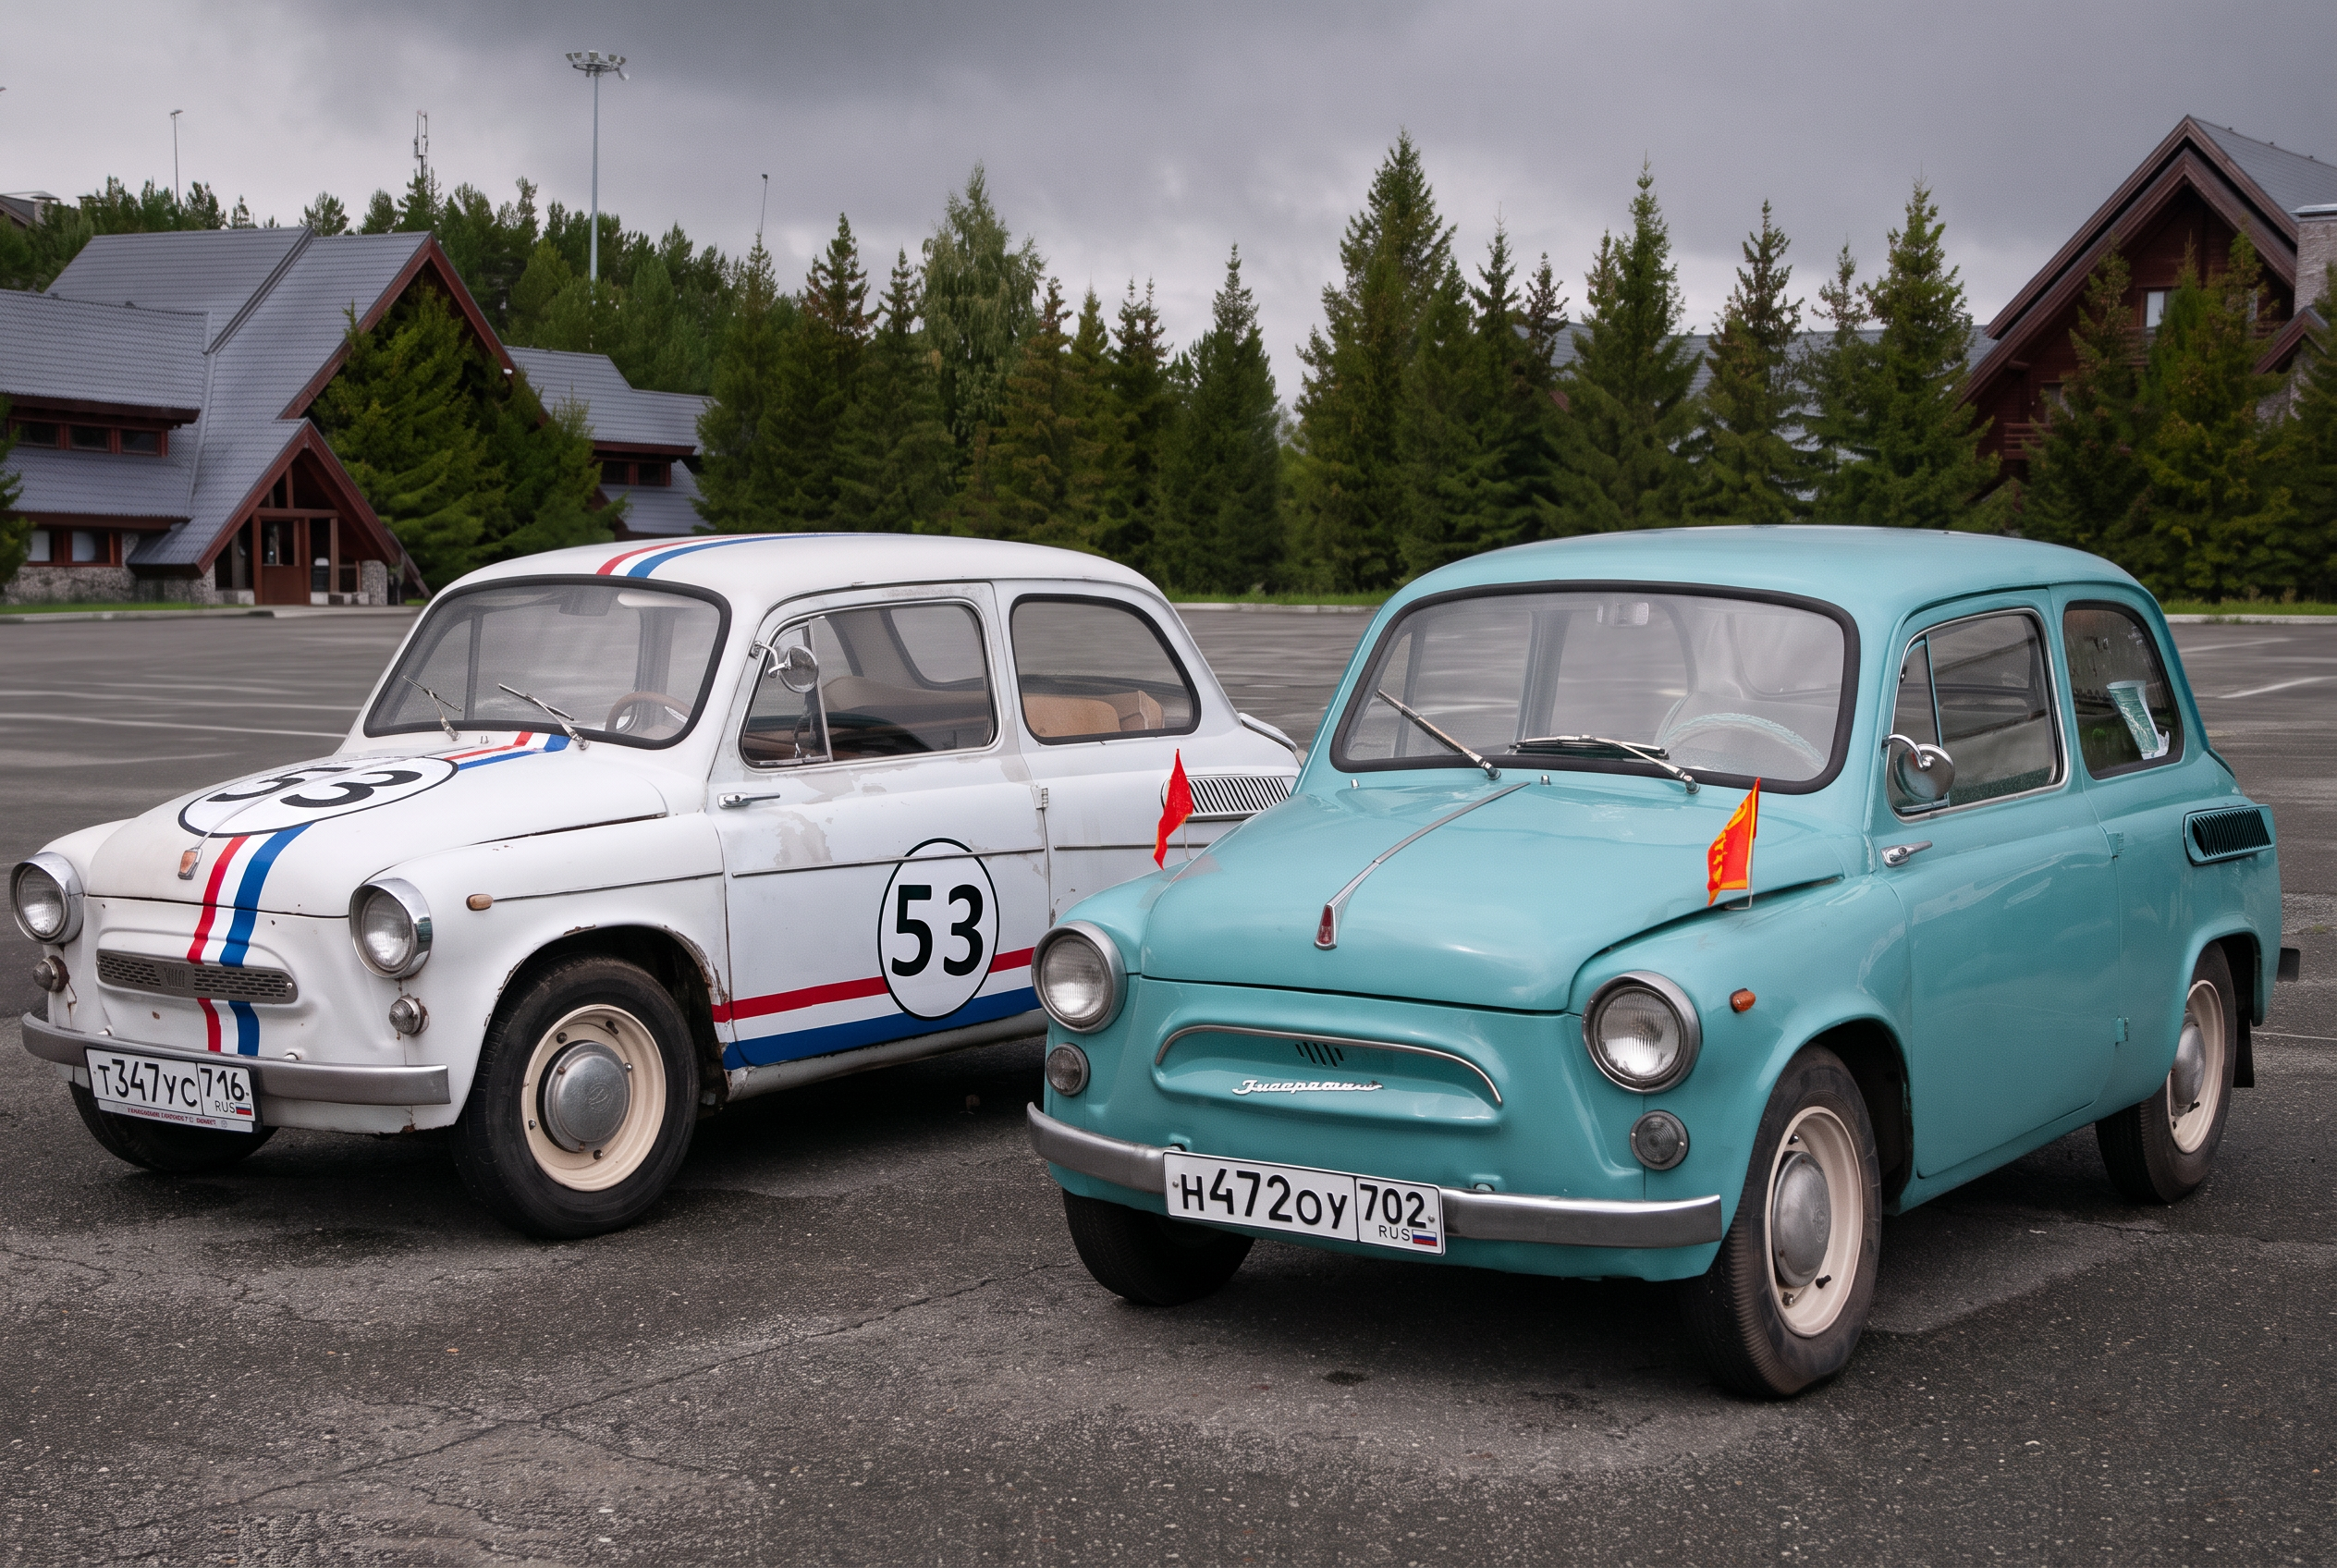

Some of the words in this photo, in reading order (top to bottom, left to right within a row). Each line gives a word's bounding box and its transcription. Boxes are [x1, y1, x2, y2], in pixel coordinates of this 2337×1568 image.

[206, 766, 422, 808] 53
[891, 884, 984, 977] 53
[200, 1067, 245, 1101] 716
[214, 1100, 235, 1113] RUS
[1360, 1182, 1426, 1229] 702
[1378, 1225, 1411, 1241] RUS
